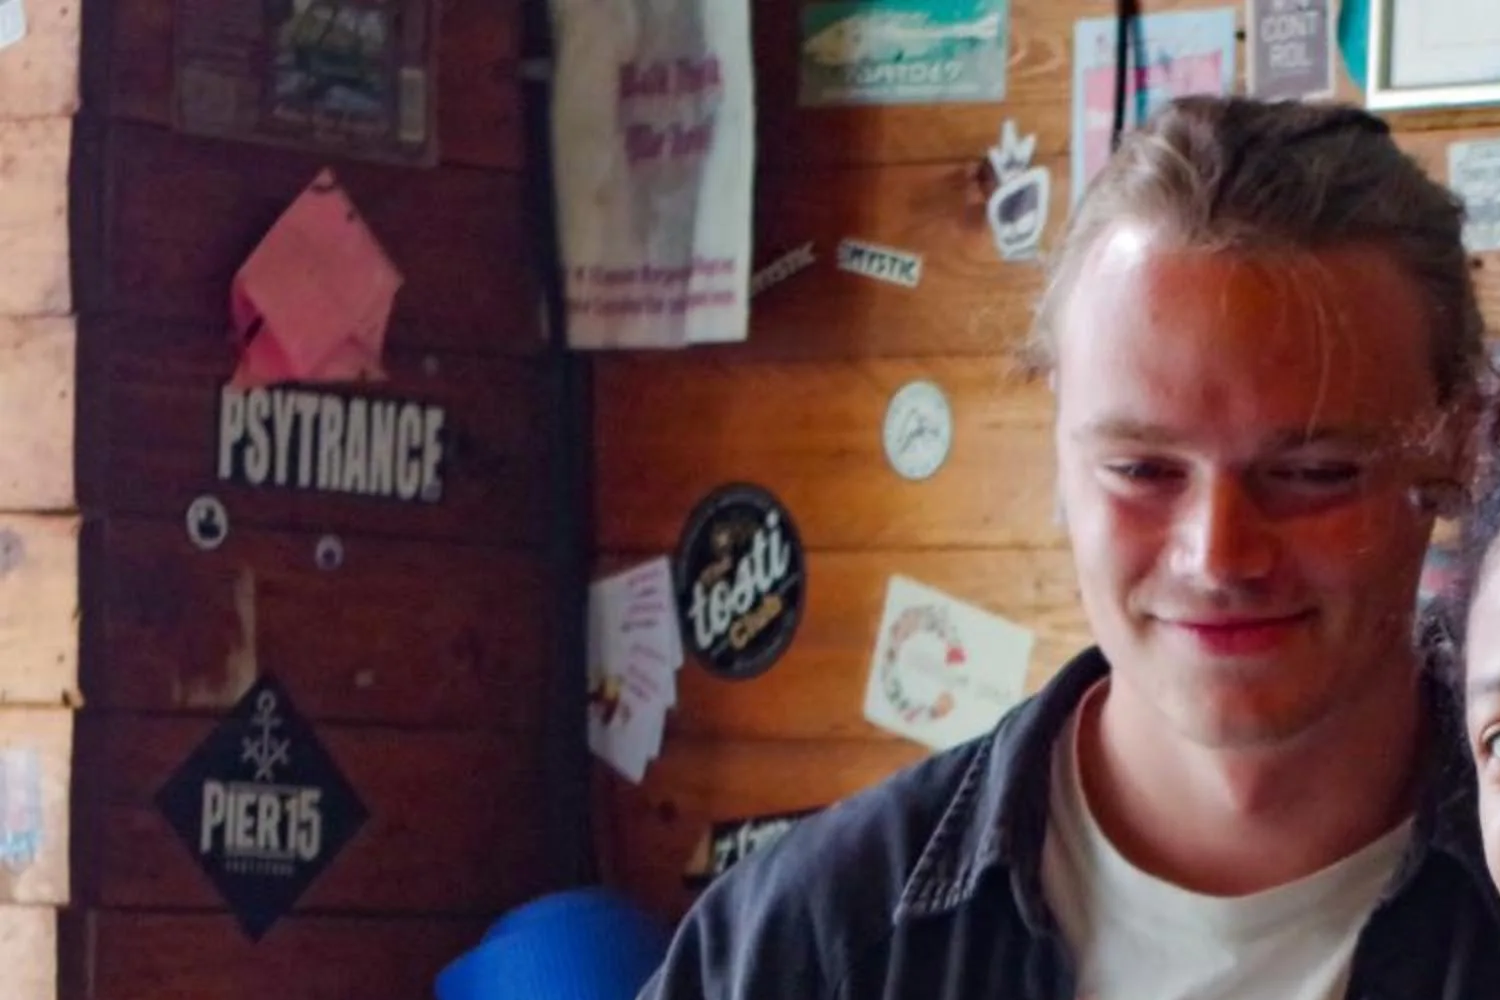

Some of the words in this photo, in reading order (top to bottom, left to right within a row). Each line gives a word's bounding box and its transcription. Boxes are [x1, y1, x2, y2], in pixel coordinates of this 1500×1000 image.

[847, 244, 916, 282] MYSTIC
[218, 385, 445, 501] PSYTRANCE
[688, 510, 791, 650] tosti
